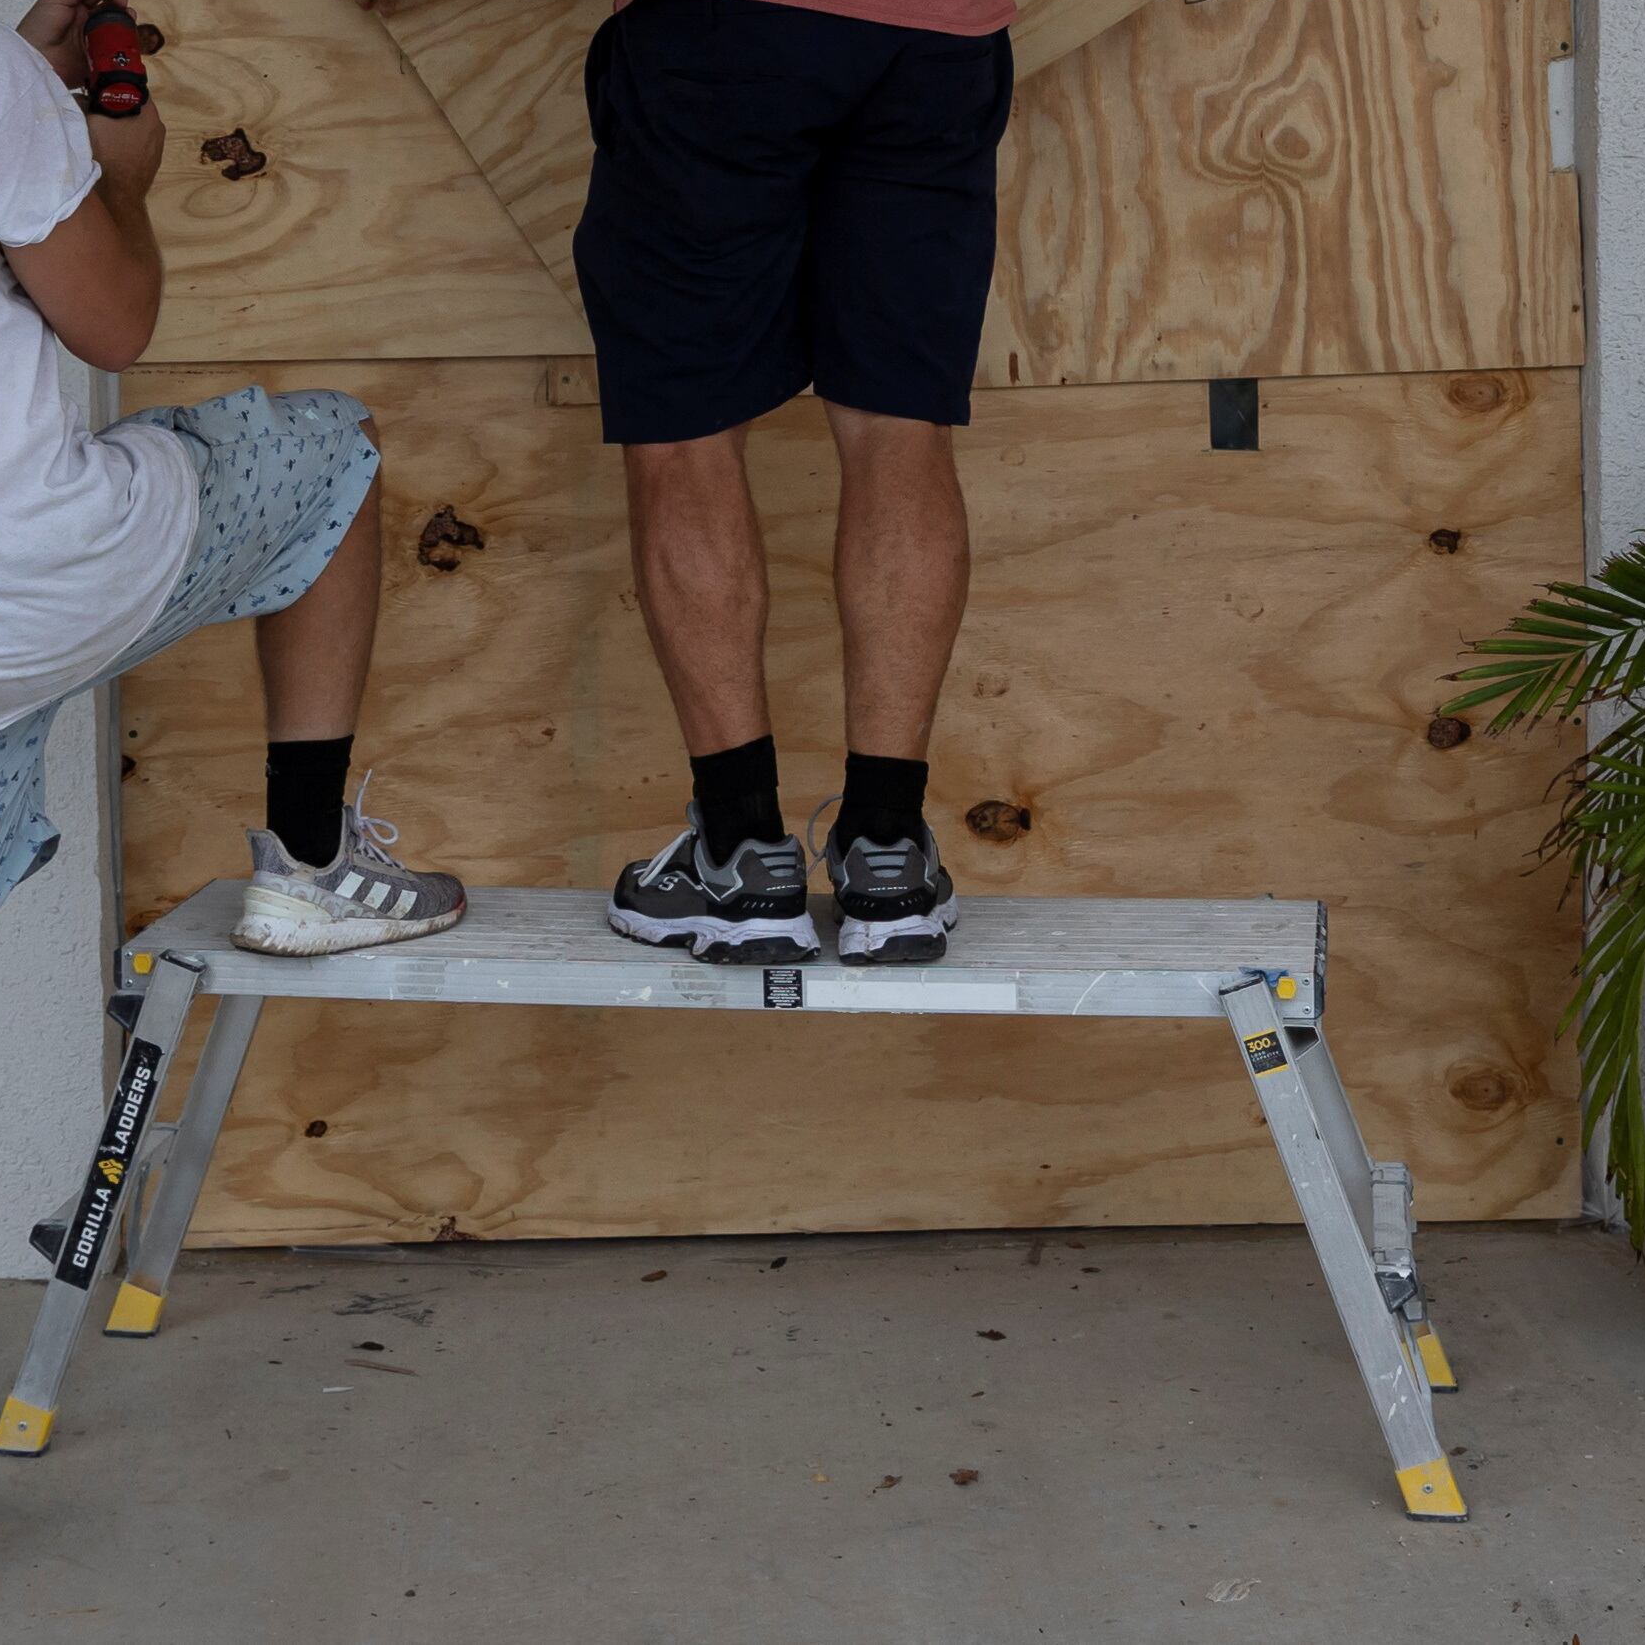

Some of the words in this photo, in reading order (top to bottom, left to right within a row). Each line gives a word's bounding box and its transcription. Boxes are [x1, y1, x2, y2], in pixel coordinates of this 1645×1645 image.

[1247, 1037, 1271, 1053] 300
[72, 1187, 113, 1269] GORILLA
[111, 1065, 152, 1155] LADDERS
